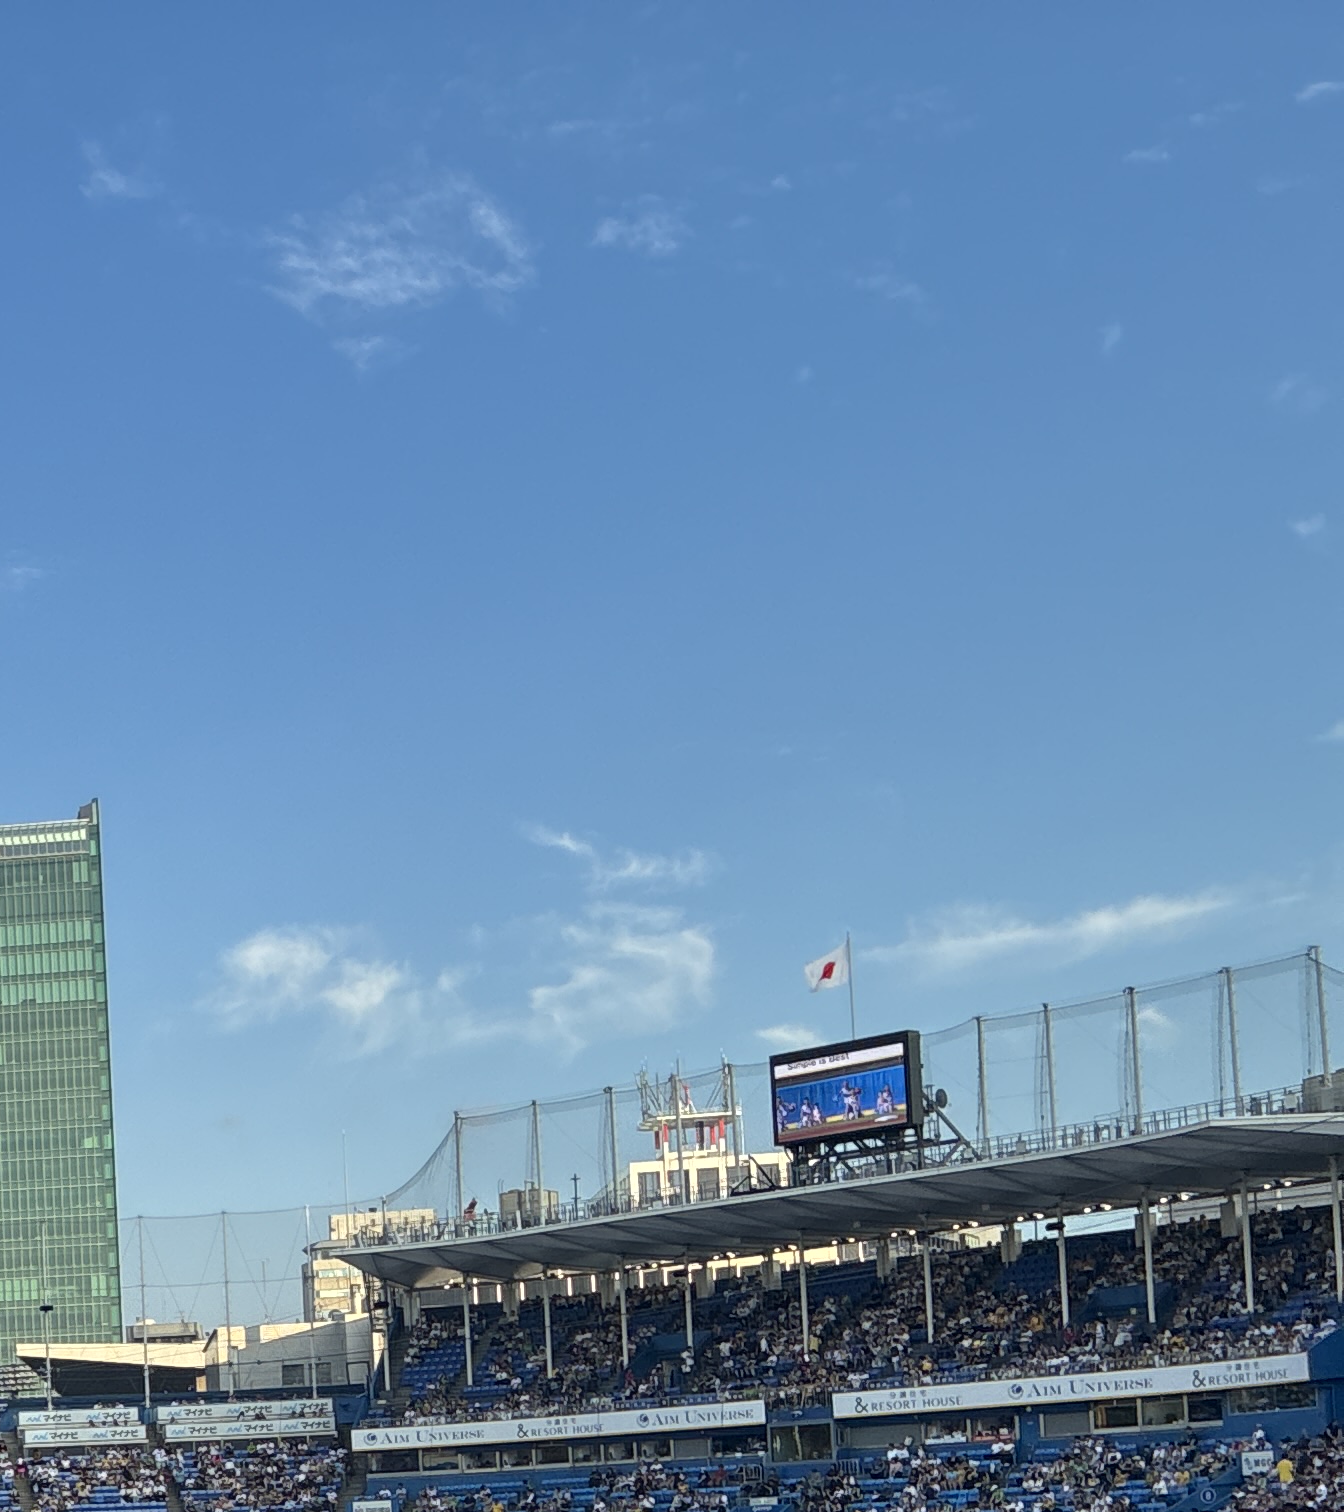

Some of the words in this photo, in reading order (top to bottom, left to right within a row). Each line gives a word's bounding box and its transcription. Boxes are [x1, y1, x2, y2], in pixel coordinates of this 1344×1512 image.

[1208, 1373, 1253, 1386] RESORT
[1254, 1369, 1289, 1382] HOUSE
[1027, 1384, 1063, 1398] AIM
[1069, 1377, 1154, 1394] UNIVERSE
[871, 1400, 917, 1412] RESORT
[922, 1397, 963, 1409] HOUSE
[183, 1408, 212, 1417] マイナビ
[243, 1405, 273, 1414] マイナビ
[43, 1414, 72, 1422] マイナビ
[102, 1412, 131, 1420] マイナビ
[652, 1412, 681, 1427] AIM
[683, 1408, 754, 1425] UNIVERSE
[244, 1424, 274, 1432] マイナビ
[301, 1421, 330, 1429] マイナビ
[109, 1430, 139, 1438] マイナビ
[188, 1427, 217, 1435] マイナビ
[530, 1426, 571, 1437] RESORT
[572, 1423, 605, 1434] HOUSE
[49, 1432, 78, 1440] マイナビ
[379, 1431, 413, 1445] AIM
[415, 1428, 485, 1443] UNIVERSE
